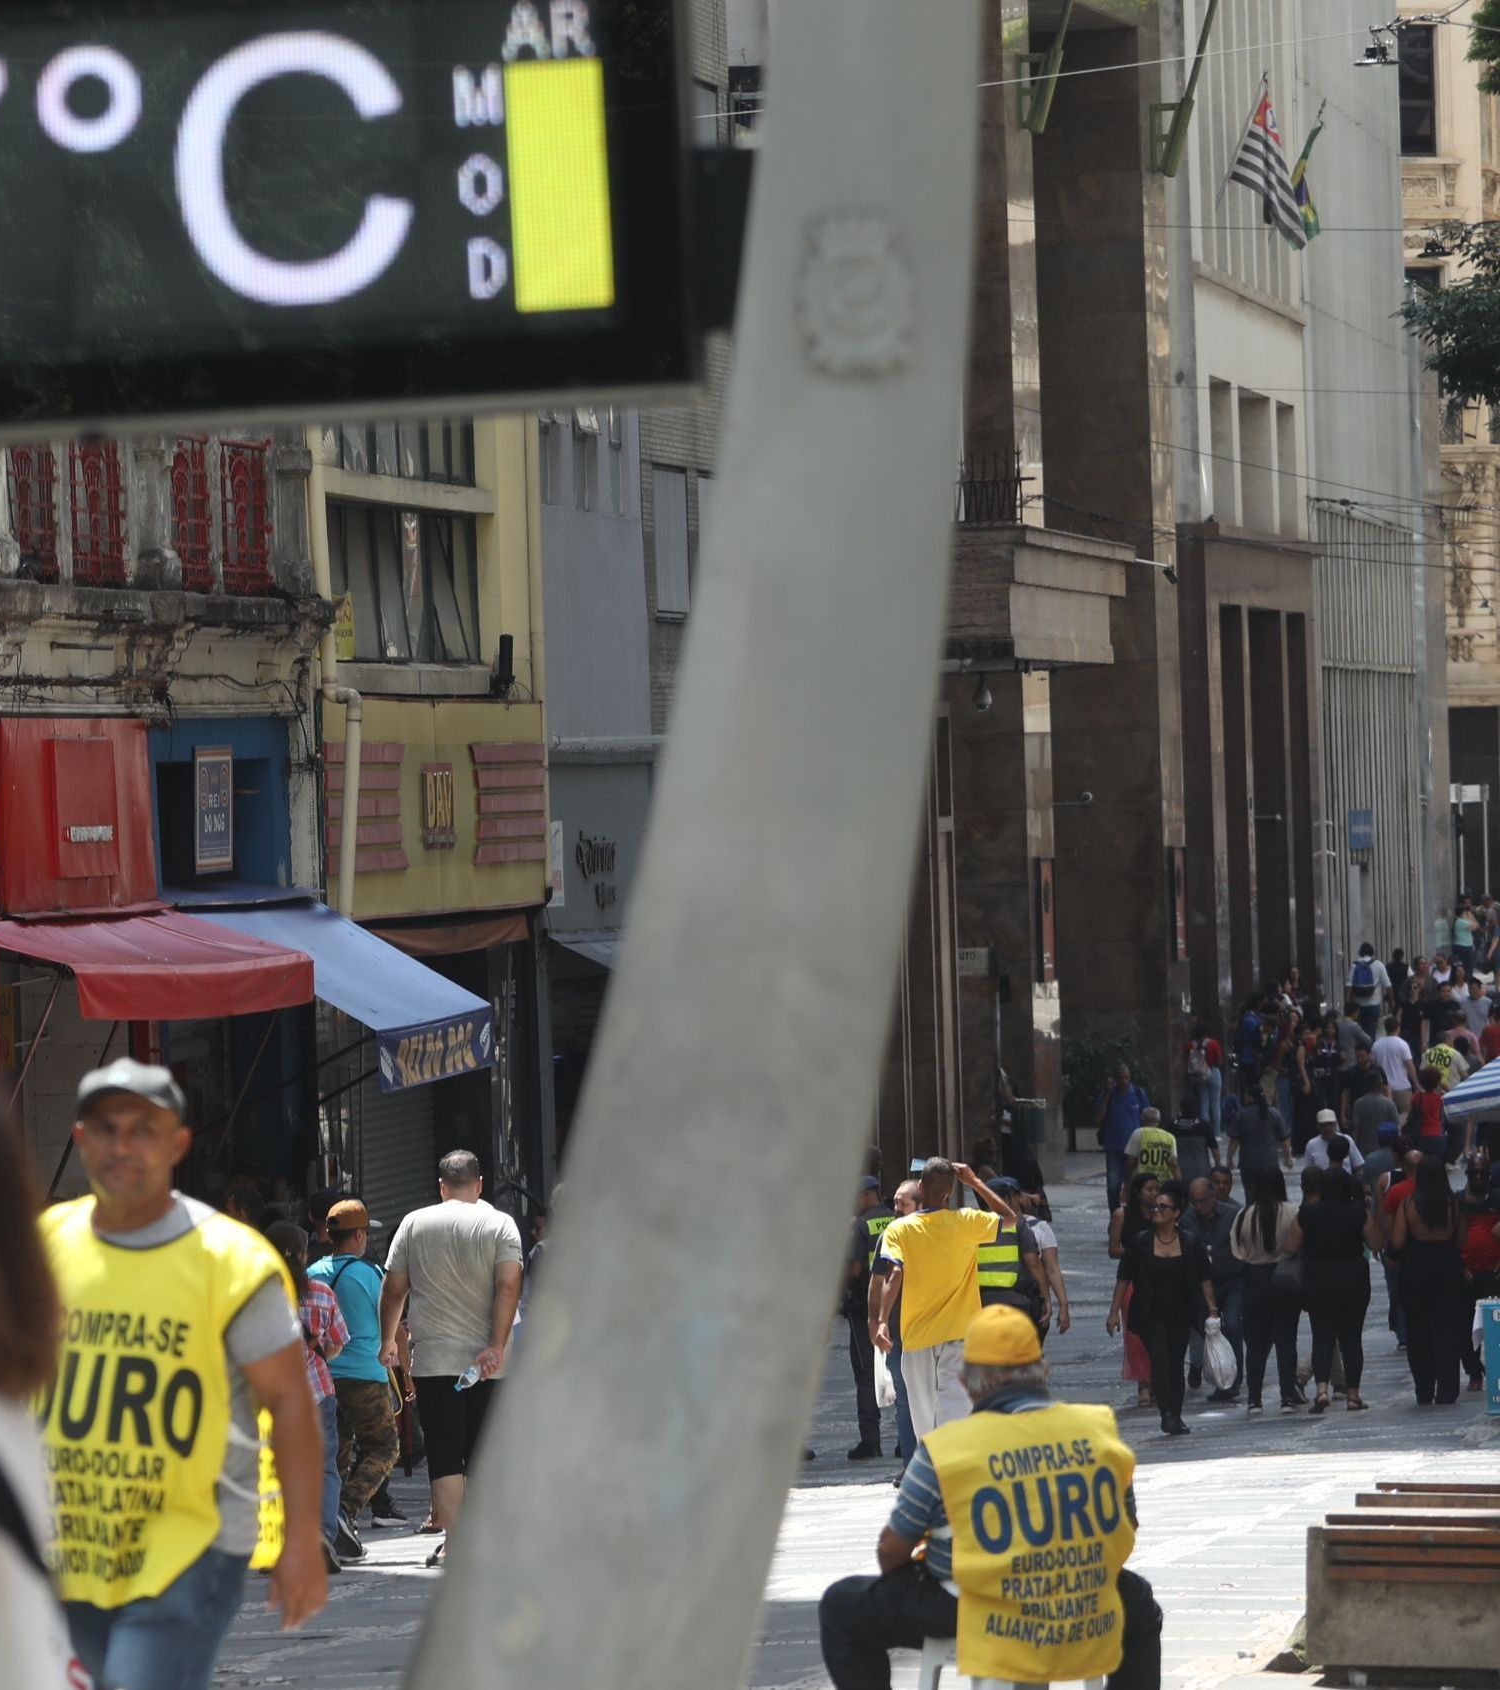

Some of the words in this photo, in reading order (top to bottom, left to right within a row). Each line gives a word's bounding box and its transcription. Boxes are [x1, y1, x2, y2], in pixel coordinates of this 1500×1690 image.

[502, 0, 596, 61] AR
[1427, 1051, 1452, 1068] URO
[989, 1439, 1096, 1481] COMPRA-SE
[971, 1466, 1120, 1555] OURO
[1021, 1594, 1098, 1621] BRILHANTE
[985, 1613, 1064, 1648] ALIANÇAS
[1067, 1625, 1085, 1644] DE
[1087, 1611, 1115, 1640] OURO
